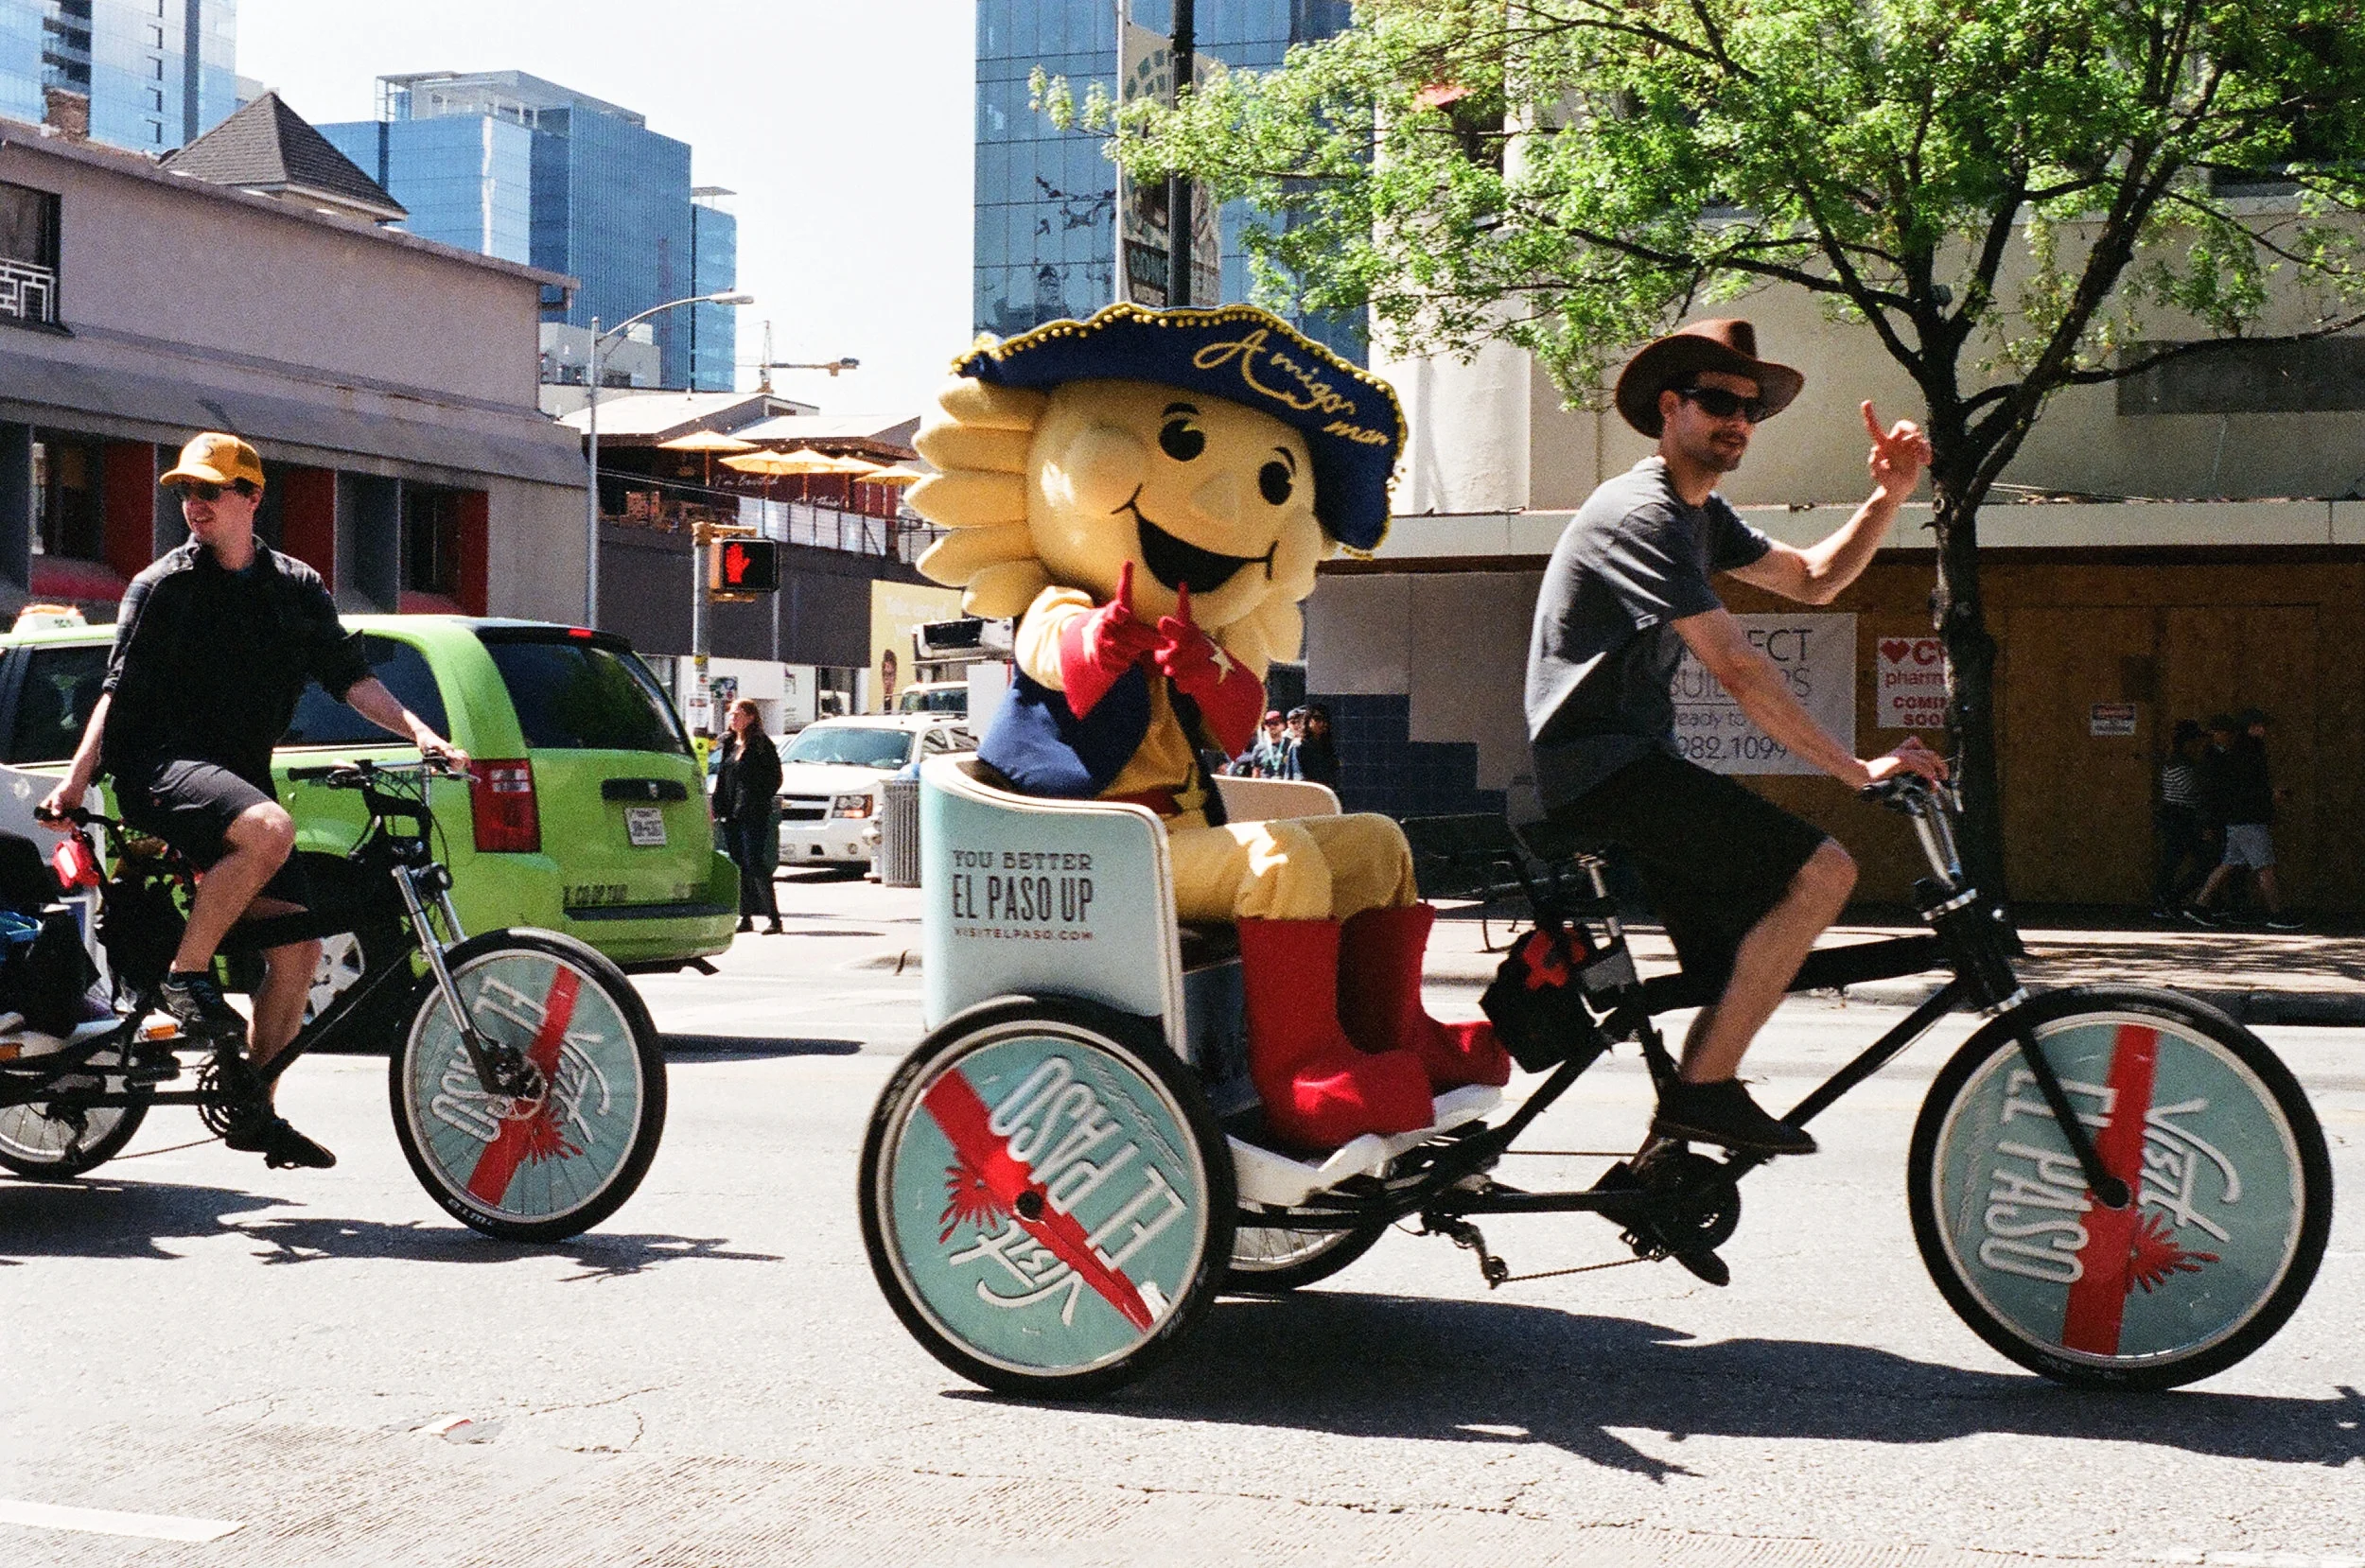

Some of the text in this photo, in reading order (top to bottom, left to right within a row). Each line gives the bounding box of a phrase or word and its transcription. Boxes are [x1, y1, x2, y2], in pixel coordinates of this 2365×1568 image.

[1884, 670, 1946, 688] pharm
[1893, 696, 1947, 709] COMIN
[1903, 713, 1946, 726] SOO
[953, 850, 1092, 870] YOU BETTER
[953, 874, 1094, 922] EL PASO UP
[955, 926, 1094, 941] VISITELPASO.COM
[2000, 1069, 2120, 1127] EL
[990, 1054, 1141, 1216] PASO
[1084, 1164, 1186, 1271] EL
[1979, 1141, 2093, 1284] PASO
